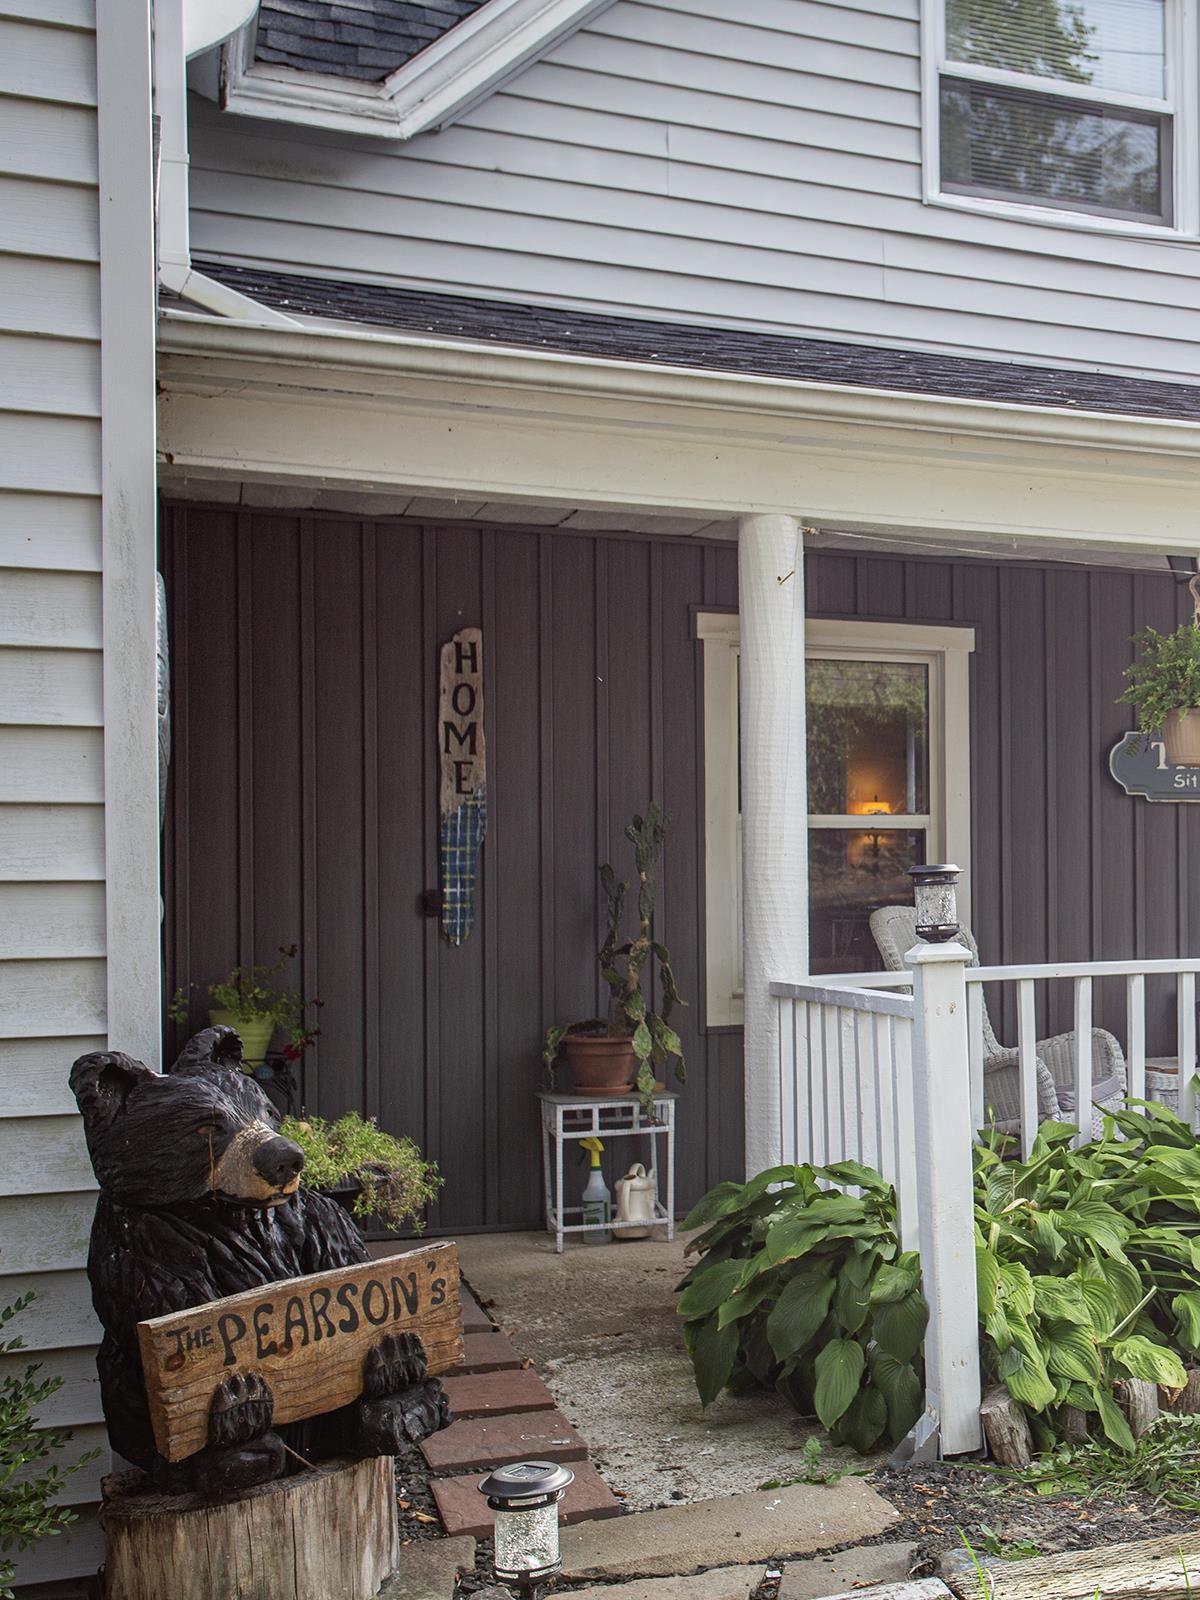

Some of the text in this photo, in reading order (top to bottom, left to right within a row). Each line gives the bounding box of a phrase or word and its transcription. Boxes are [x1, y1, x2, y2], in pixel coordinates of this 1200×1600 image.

[443, 641, 478, 796] HOME
[1173, 773, 1198, 789] Sit
[166, 1324, 213, 1355] THE
